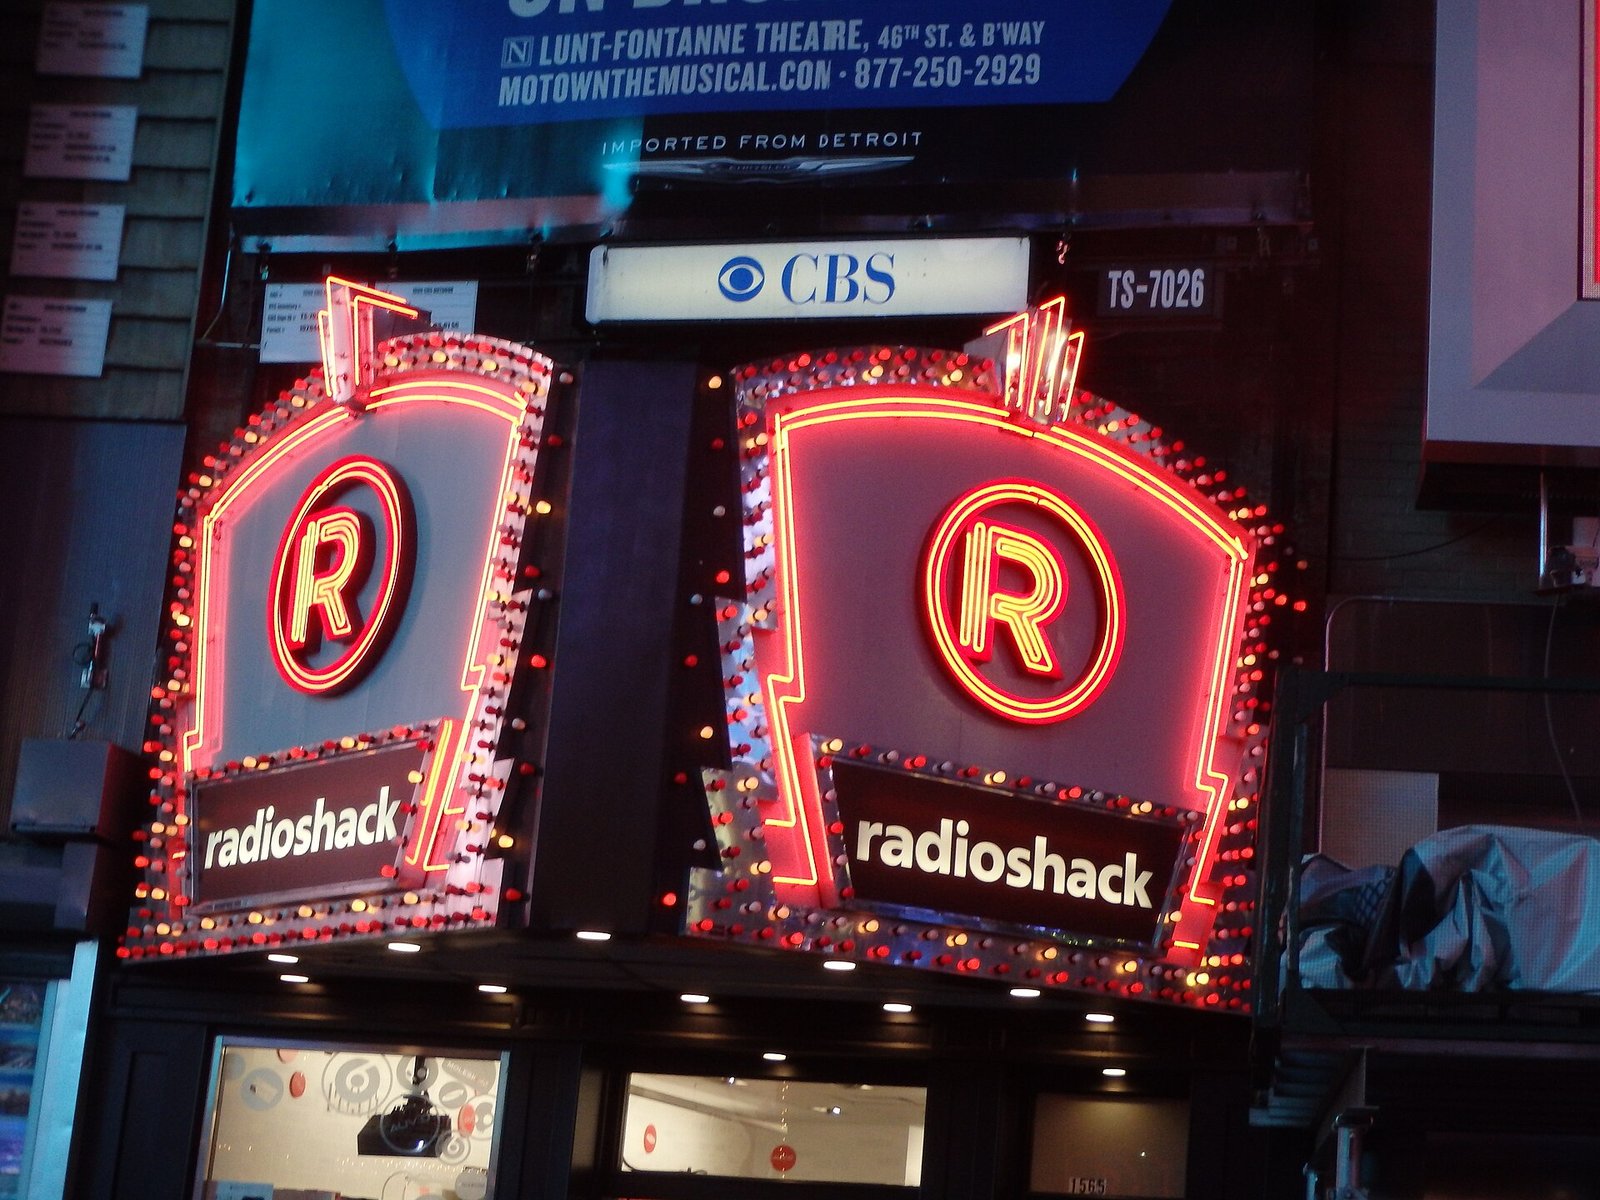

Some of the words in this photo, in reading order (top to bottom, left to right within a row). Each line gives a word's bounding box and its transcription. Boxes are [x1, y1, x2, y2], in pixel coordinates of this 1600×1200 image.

[539, 24, 747, 66] LUNT-FONTANNE
[755, 19, 869, 54] THEATRE,
[924, 24, 952, 48] ST.
[959, 23, 976, 47] &
[982, 21, 1046, 47] B'WAY
[854, 53, 1042, 89] 877-250-2929
[602, 135, 727, 155] IMPORTED
[739, 134, 806, 149] FROM
[818, 131, 923, 148] DETROIT
[781, 252, 897, 305] CBS
[1108, 268, 1205, 309] TS-7026
[204, 786, 401, 870] radioshack
[856, 818, 1153, 909] radioshack
